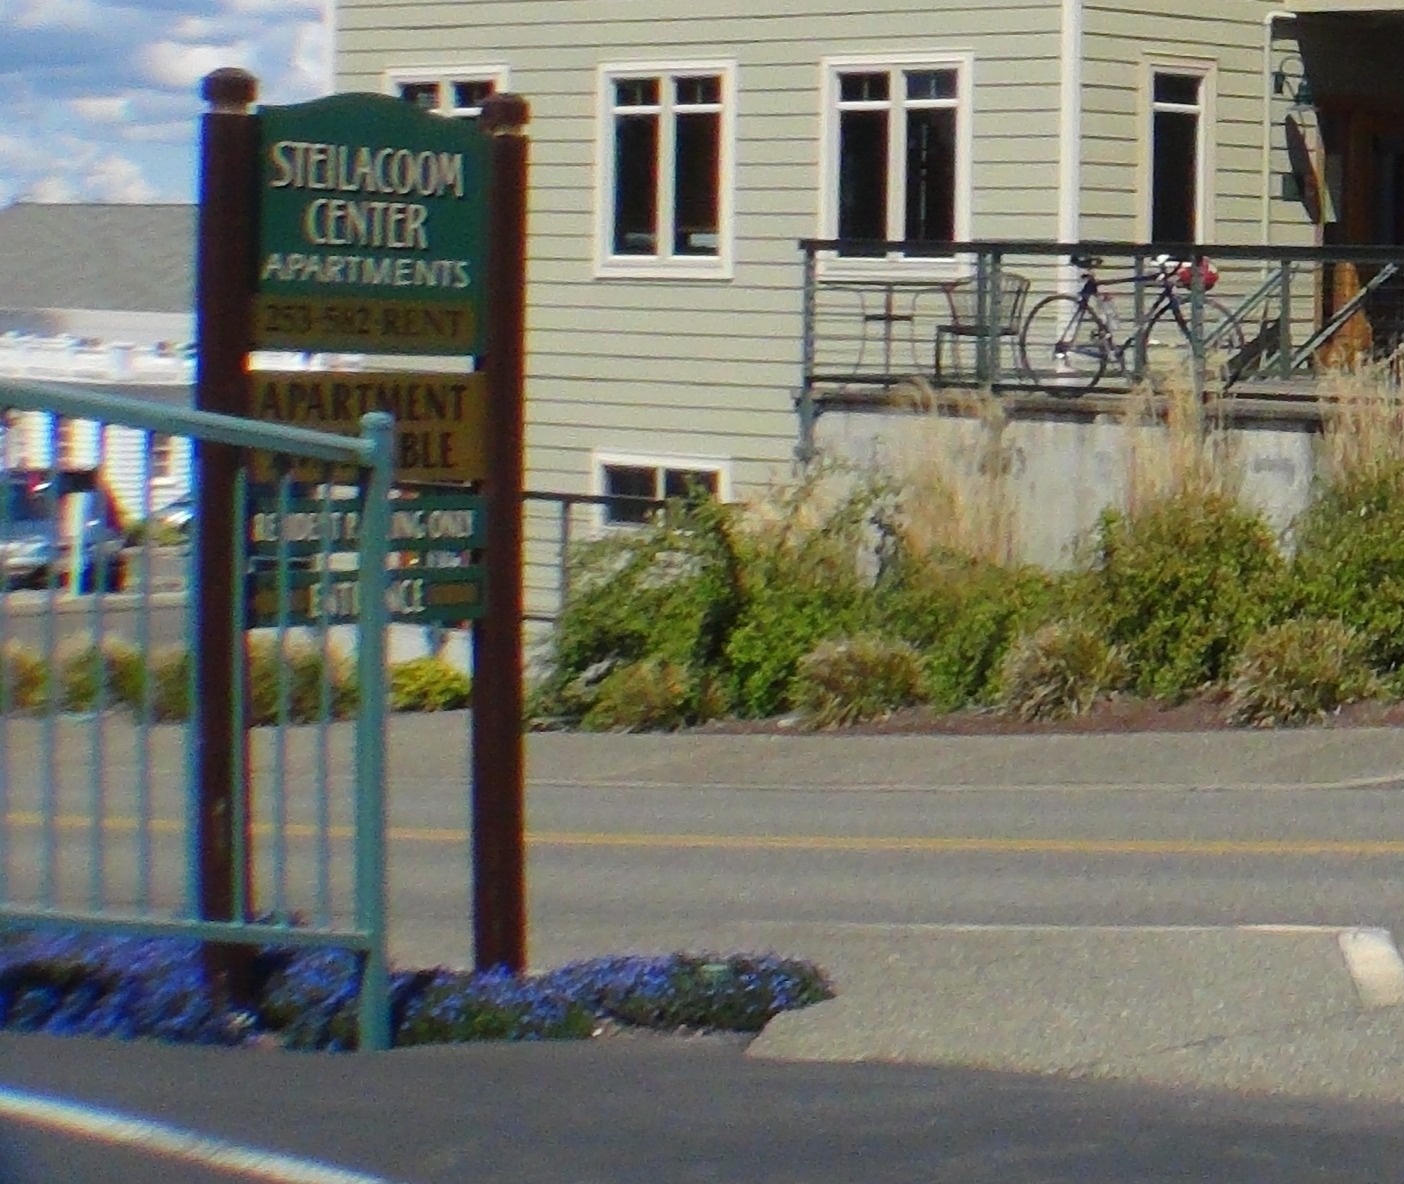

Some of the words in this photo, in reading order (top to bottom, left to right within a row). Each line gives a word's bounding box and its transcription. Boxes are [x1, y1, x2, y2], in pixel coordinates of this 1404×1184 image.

[269, 140, 465, 198] STEILACOOM
[304, 198, 429, 250] CENTER
[260, 252, 472, 289] APARTMENTS
